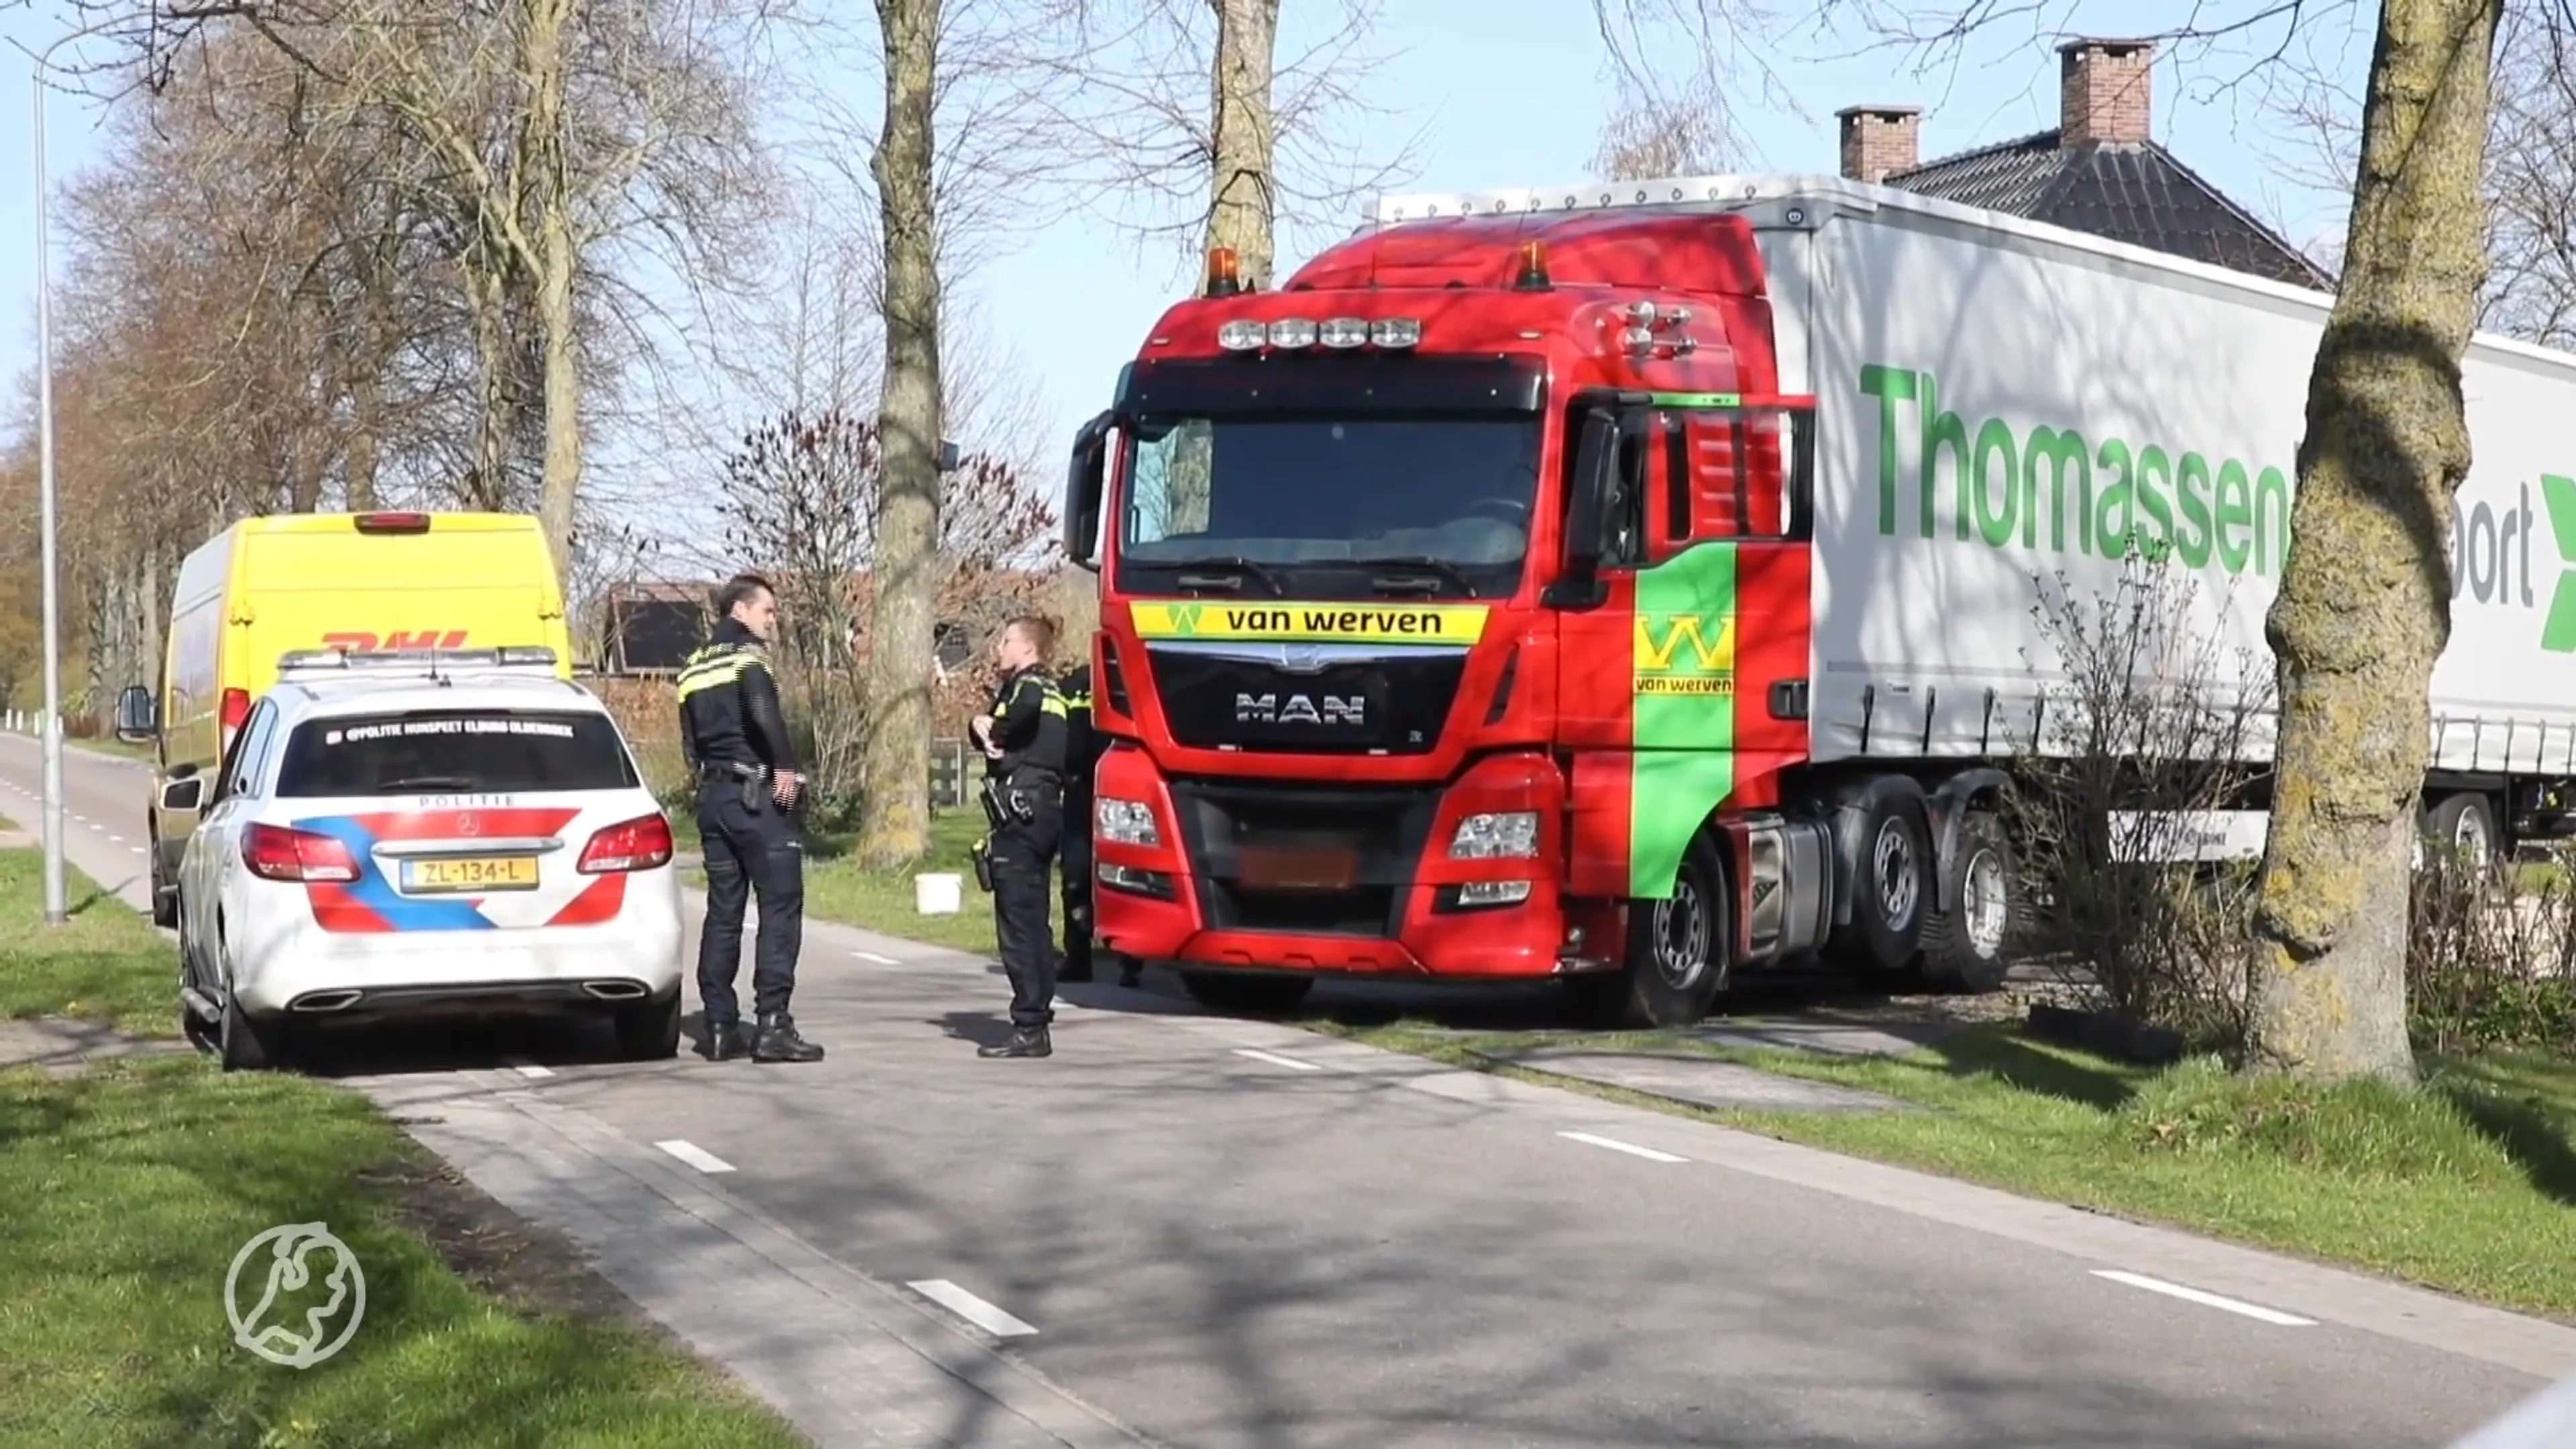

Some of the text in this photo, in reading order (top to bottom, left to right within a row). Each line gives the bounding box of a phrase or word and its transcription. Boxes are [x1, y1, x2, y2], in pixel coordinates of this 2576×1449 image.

[1860, 363, 2291, 576] Thomassen
[1227, 609, 1442, 634] van werven
[1635, 678, 1731, 692] van werven
[1236, 692, 1365, 724] MAN
[419, 794, 515, 807] POLITIE
[424, 860, 521, 884] ZL-134-L
